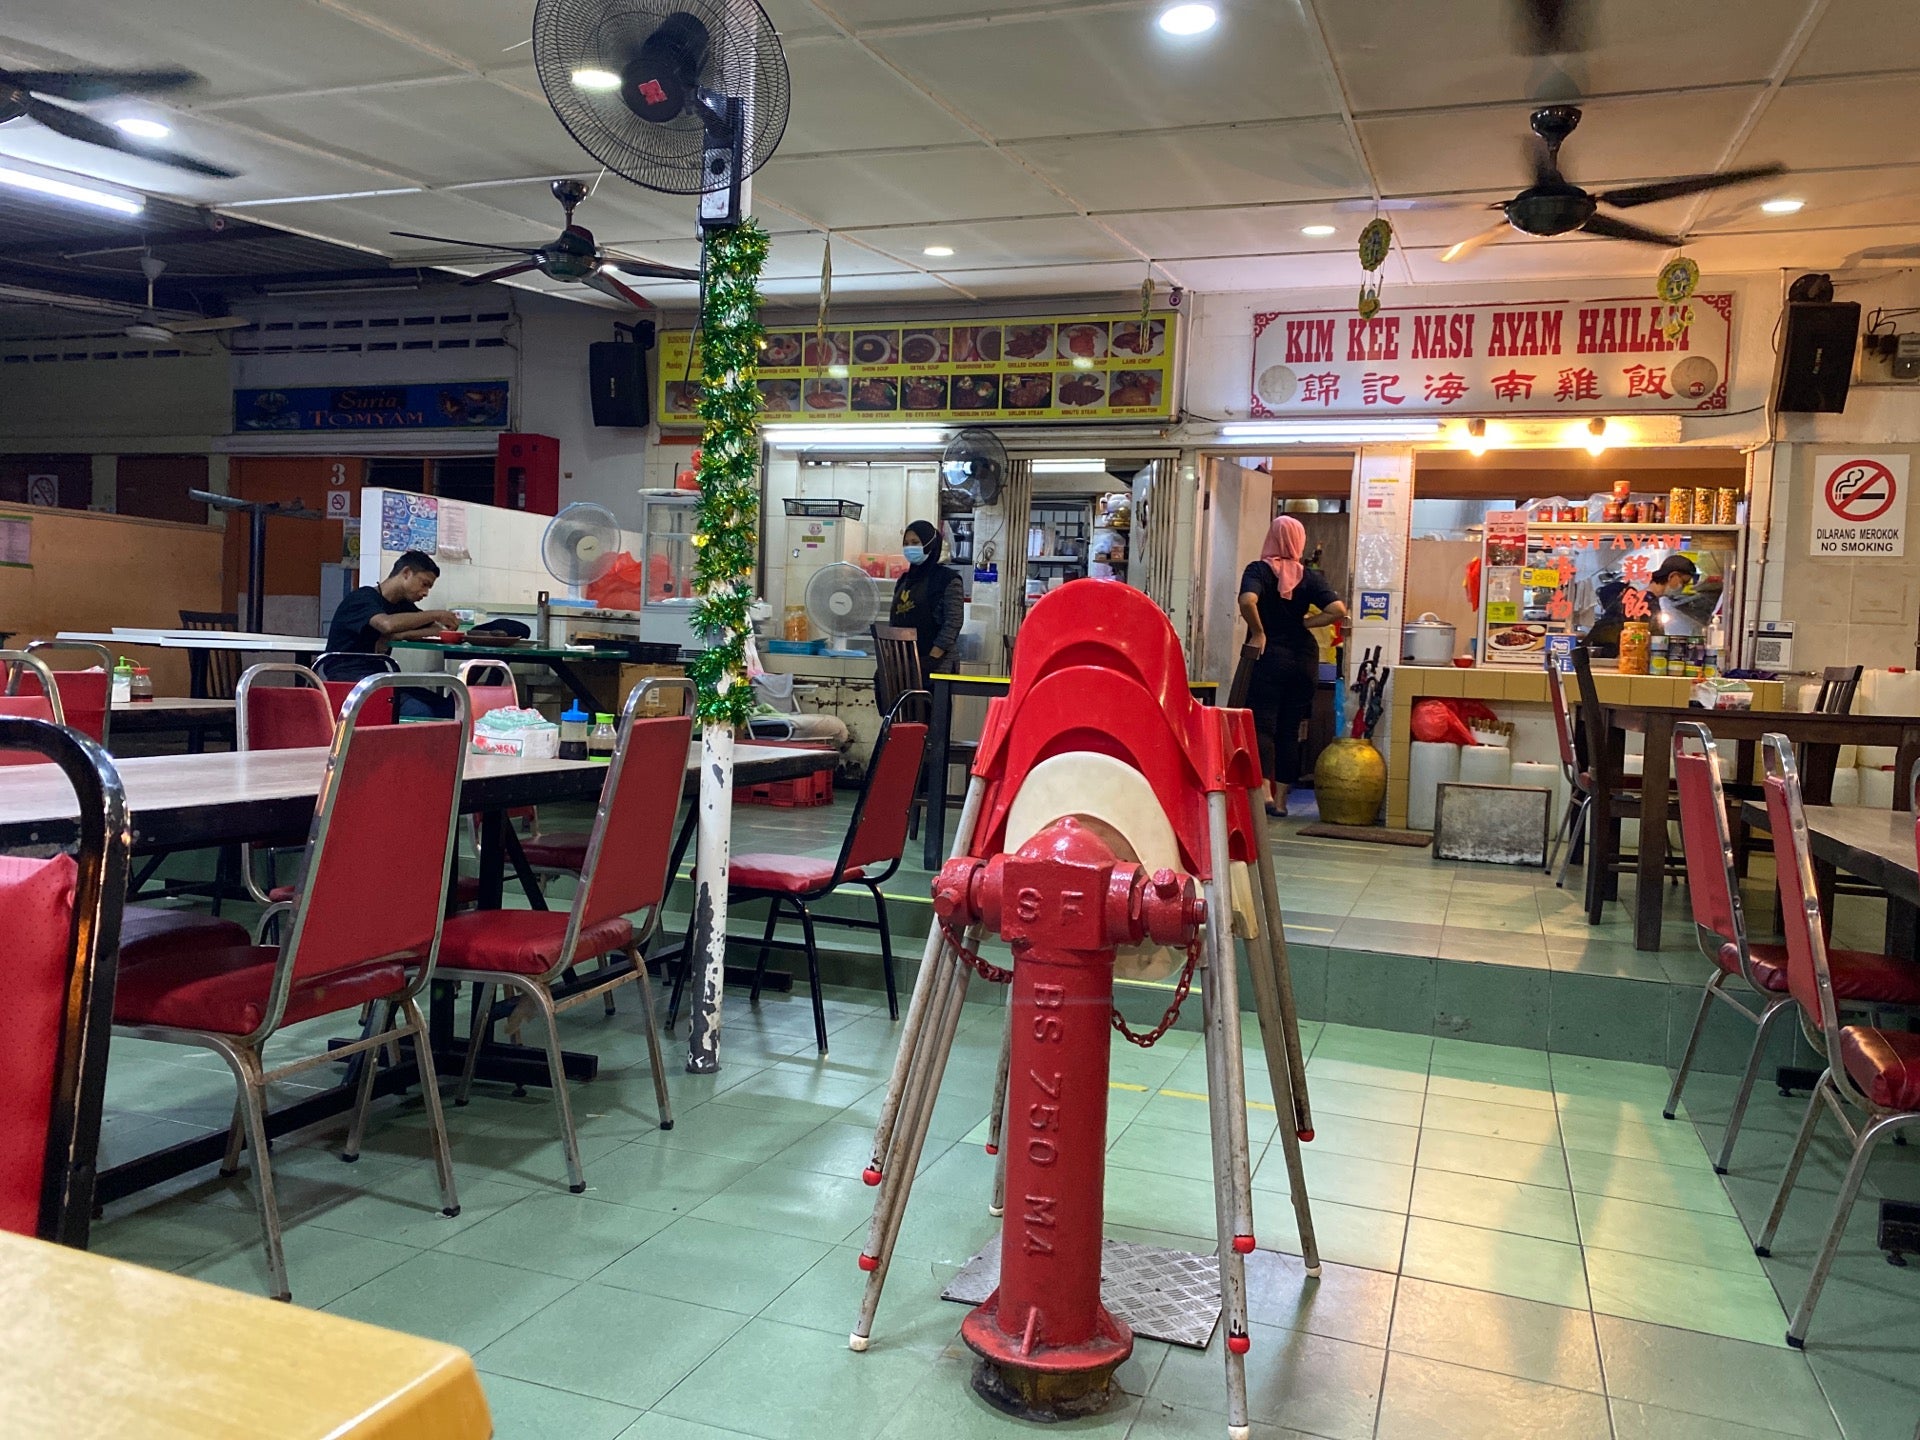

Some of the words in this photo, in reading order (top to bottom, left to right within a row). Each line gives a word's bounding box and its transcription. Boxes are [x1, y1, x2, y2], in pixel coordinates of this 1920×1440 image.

[1285, 318, 1335, 363] KIM
[1347, 316, 1400, 361] KEE
[1411, 313, 1474, 359] NASI
[1488, 310, 1562, 357] AYAM
[331, 463, 346, 486] 3
[1542, 533, 1602, 550] NASI
[1610, 533, 1682, 550] AYAM
[1816, 529, 1856, 540] DILARANG
[1860, 529, 1899, 540] MEROKOK
[1821, 542, 1837, 552] NO
[1841, 542, 1893, 552] SMOKING
[1363, 595, 1387, 603] Touch
[1032, 982, 1065, 1043] BS
[1027, 1068, 1063, 1168] 750
